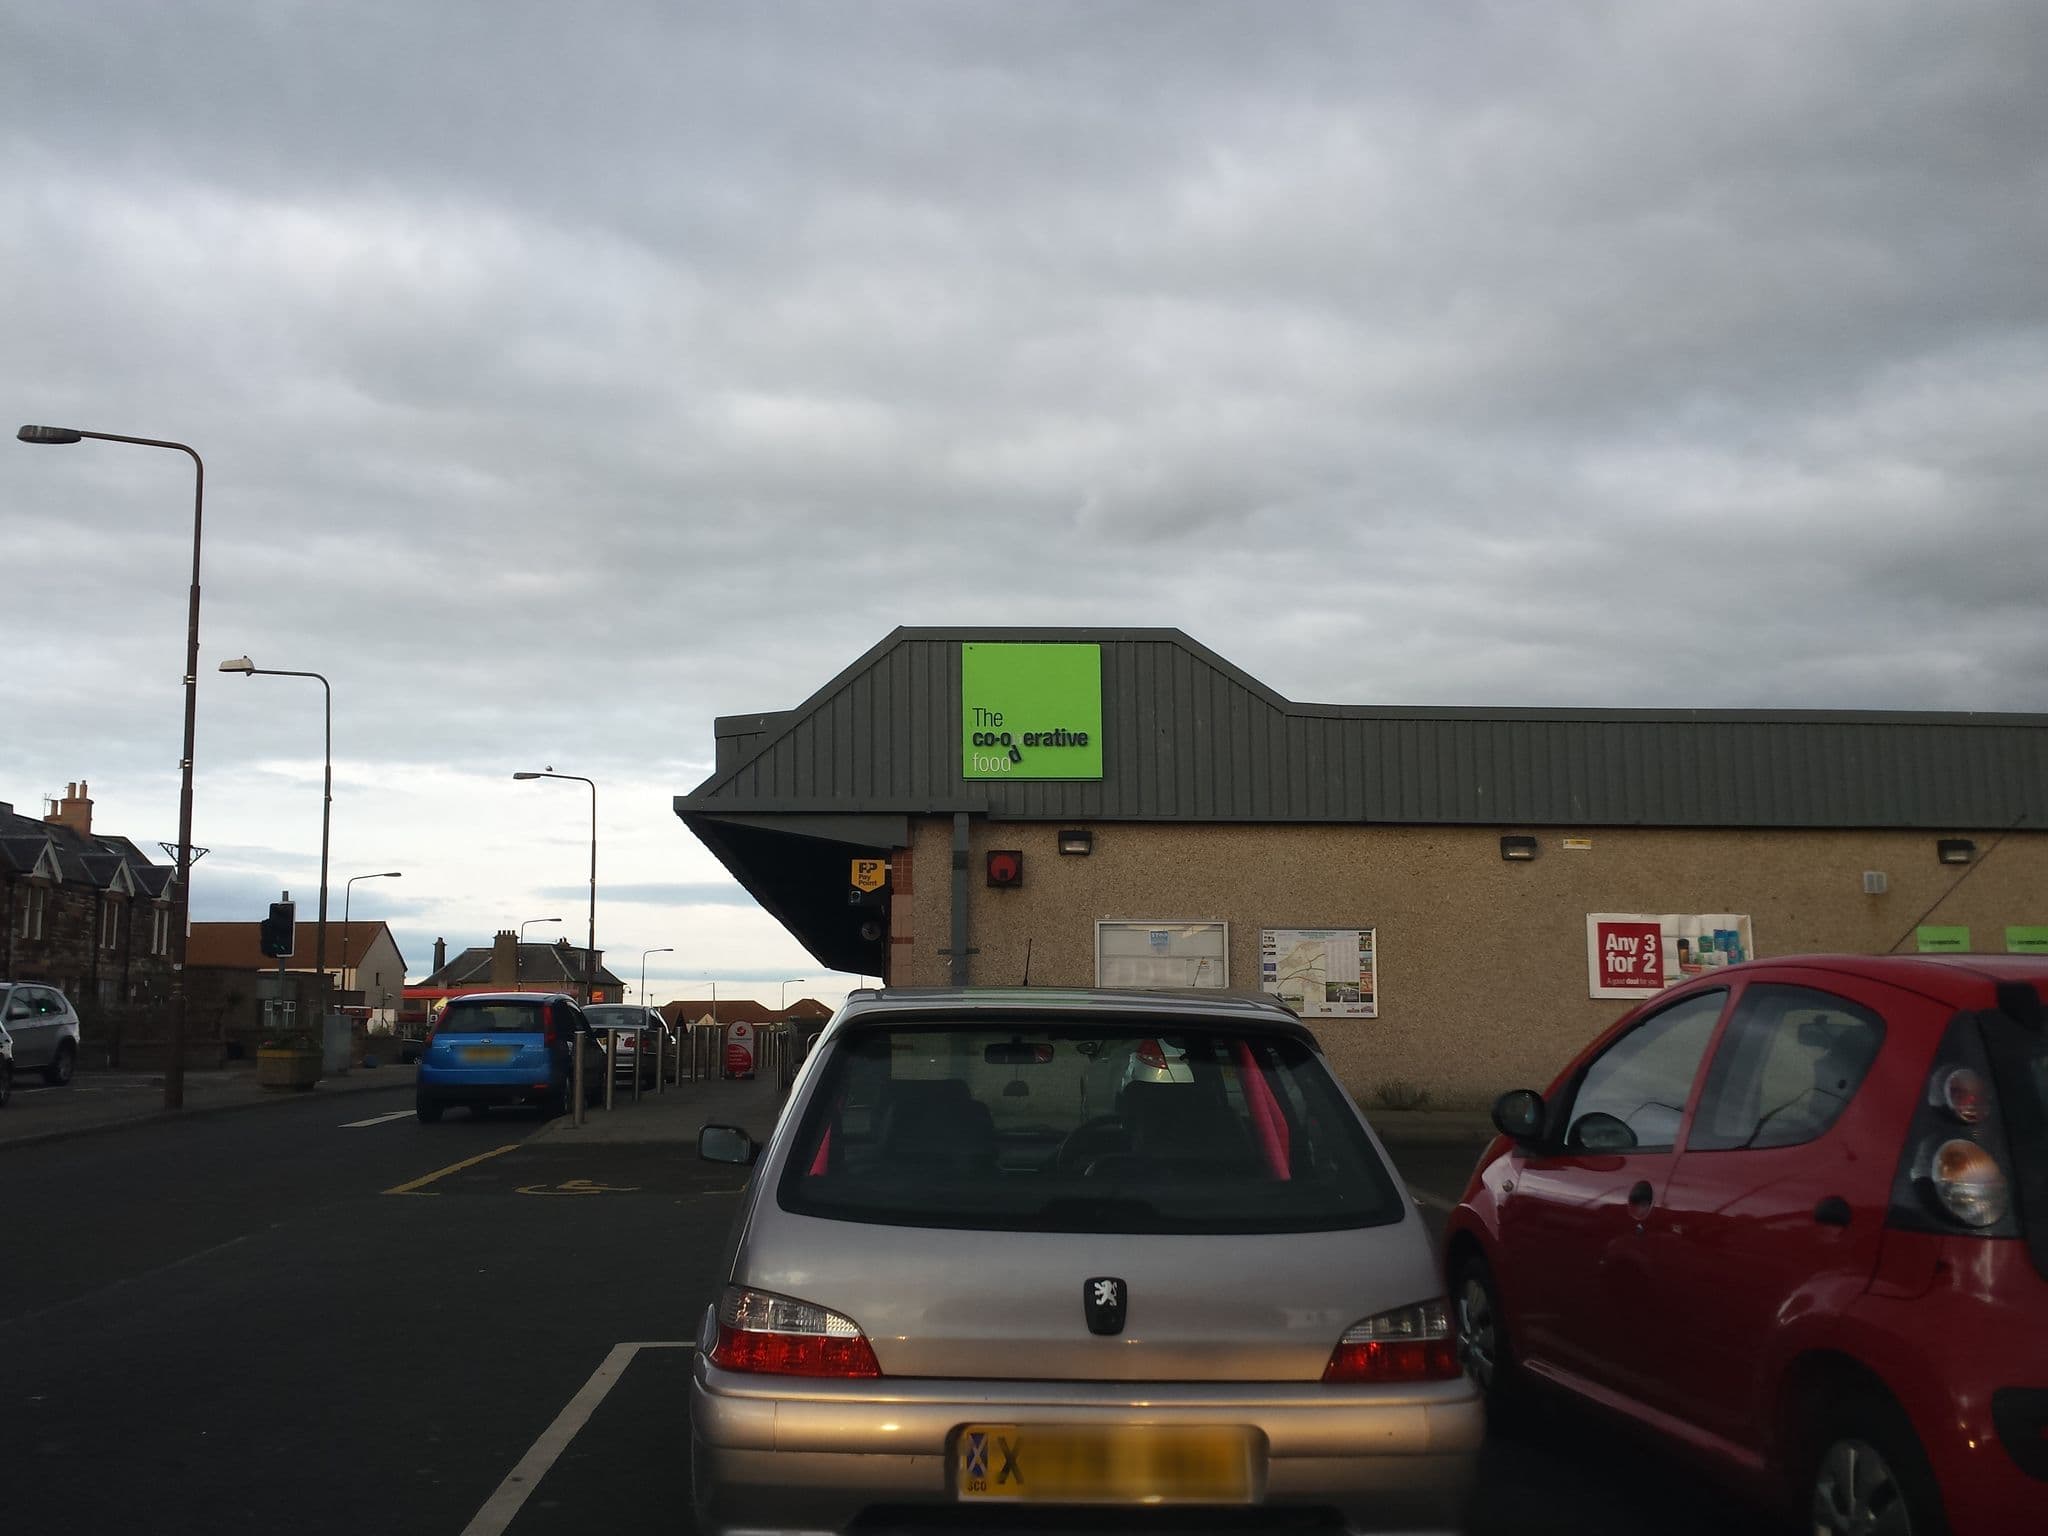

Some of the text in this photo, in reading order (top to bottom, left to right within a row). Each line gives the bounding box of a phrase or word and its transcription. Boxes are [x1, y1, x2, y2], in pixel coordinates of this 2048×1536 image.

[972, 707, 1003, 727] The
[972, 752, 1011, 772] food
[1605, 933, 1656, 955] Any 3
[1606, 951, 1657, 974] for 2
